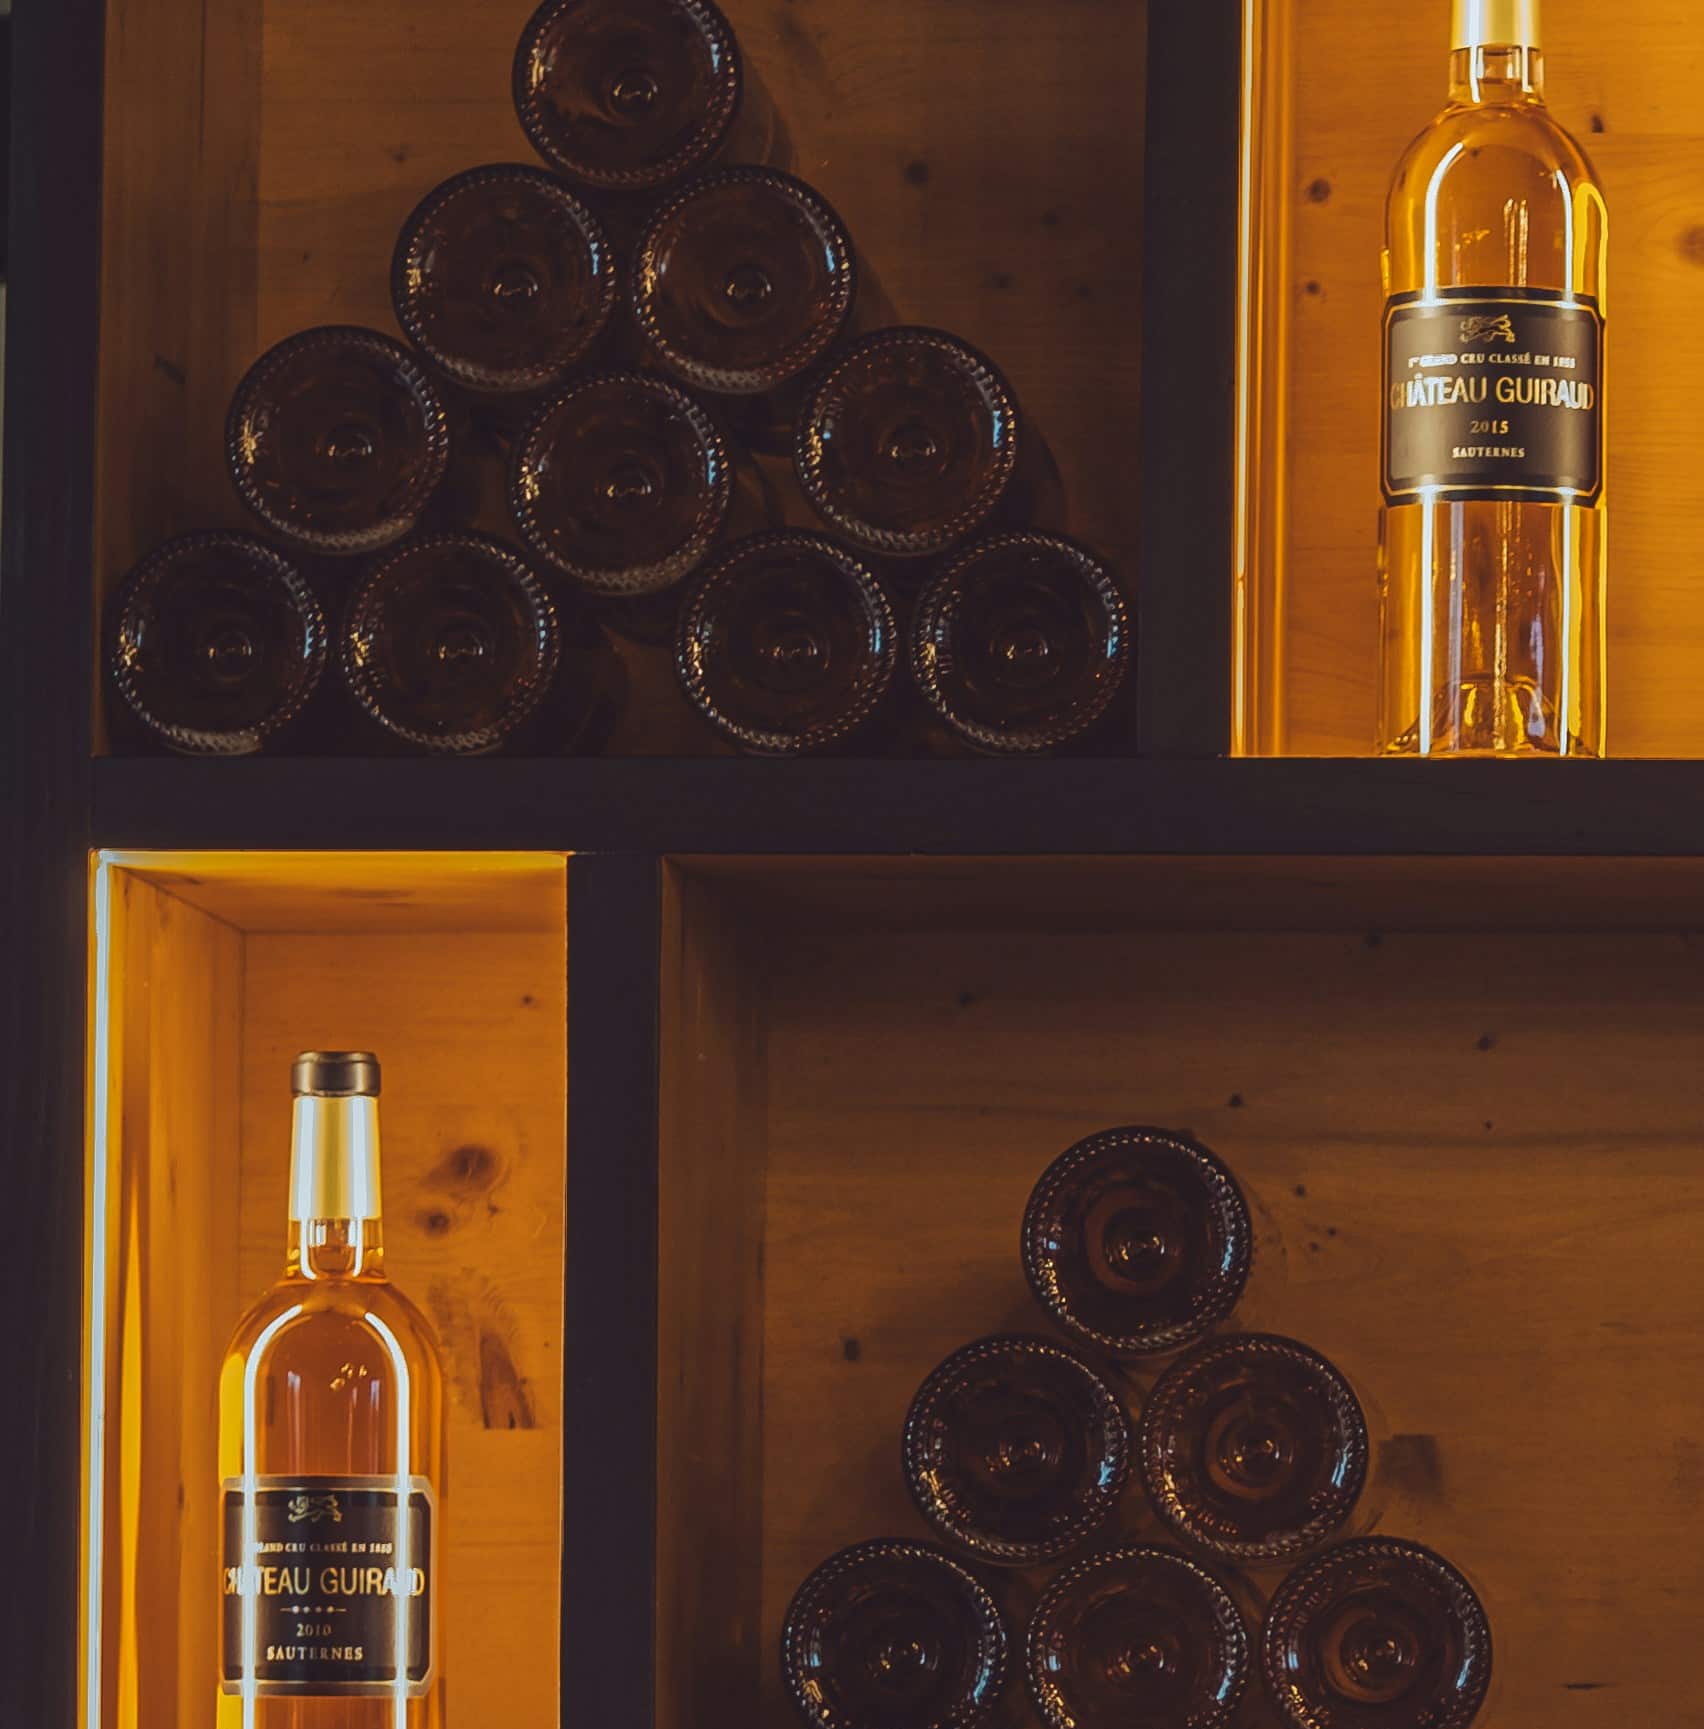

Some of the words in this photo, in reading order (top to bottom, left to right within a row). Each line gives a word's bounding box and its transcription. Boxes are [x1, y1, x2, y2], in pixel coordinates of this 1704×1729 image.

[1460, 352, 1486, 364] CRU
[1496, 376, 1594, 410] GUIRAUD
[1470, 419, 1509, 434] 2015
[1452, 446, 1525, 458] SAUTERNES
[266, 1645, 364, 1661] SAUTERNES
